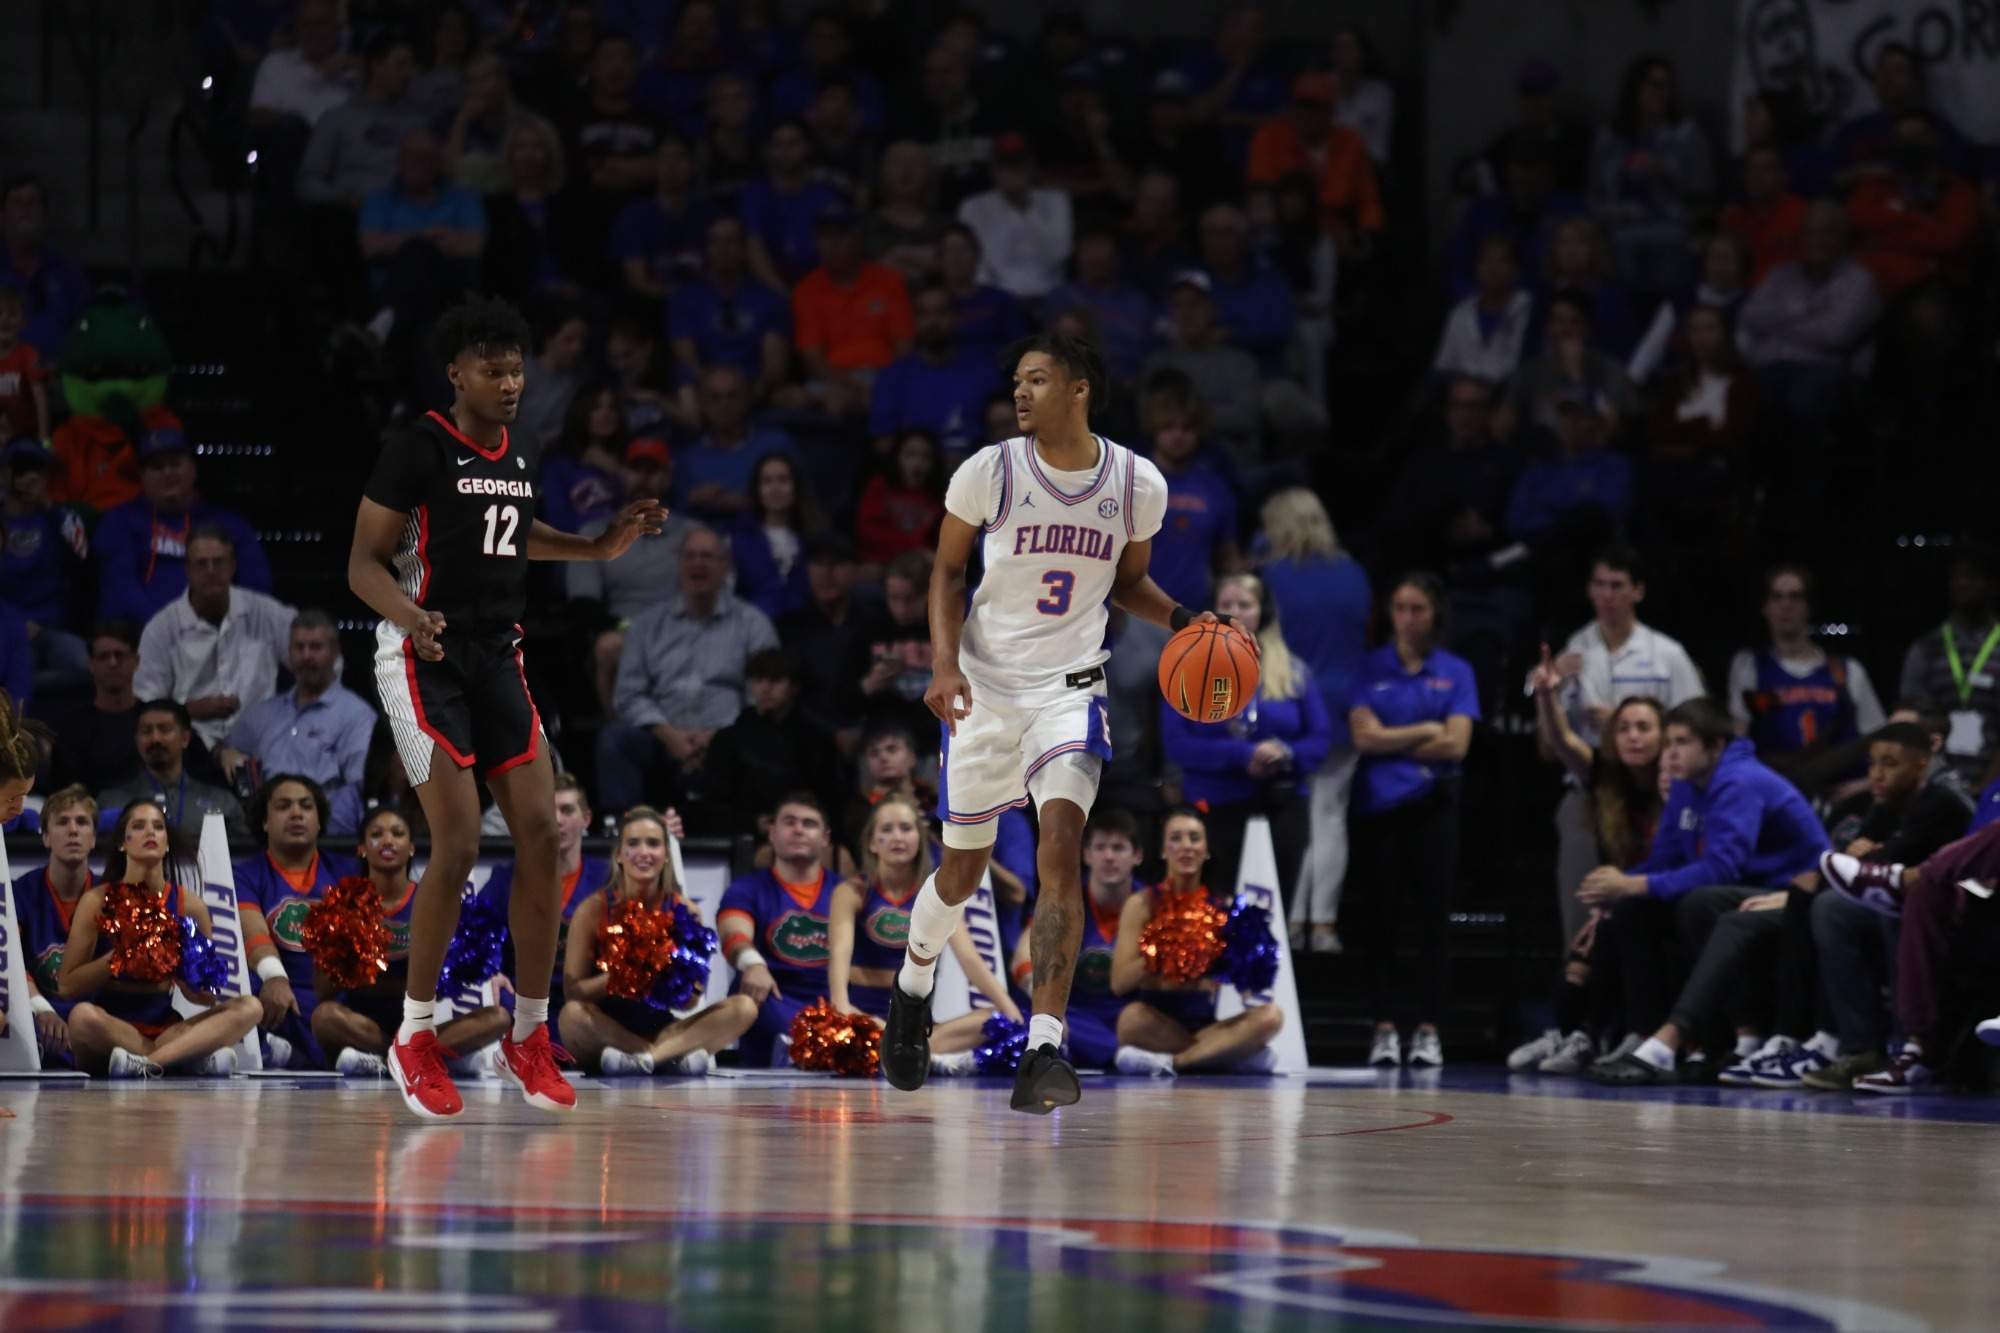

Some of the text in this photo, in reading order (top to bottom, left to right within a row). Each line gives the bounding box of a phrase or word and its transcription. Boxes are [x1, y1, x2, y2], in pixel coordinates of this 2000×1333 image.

[457, 478, 533, 498] GEORGIA
[1099, 499, 1118, 518] SEC
[483, 504, 519, 556] 12
[1013, 524, 1113, 561] FLORIDA
[1036, 570, 1076, 616] 3
[1208, 678, 1228, 720] ELITE
